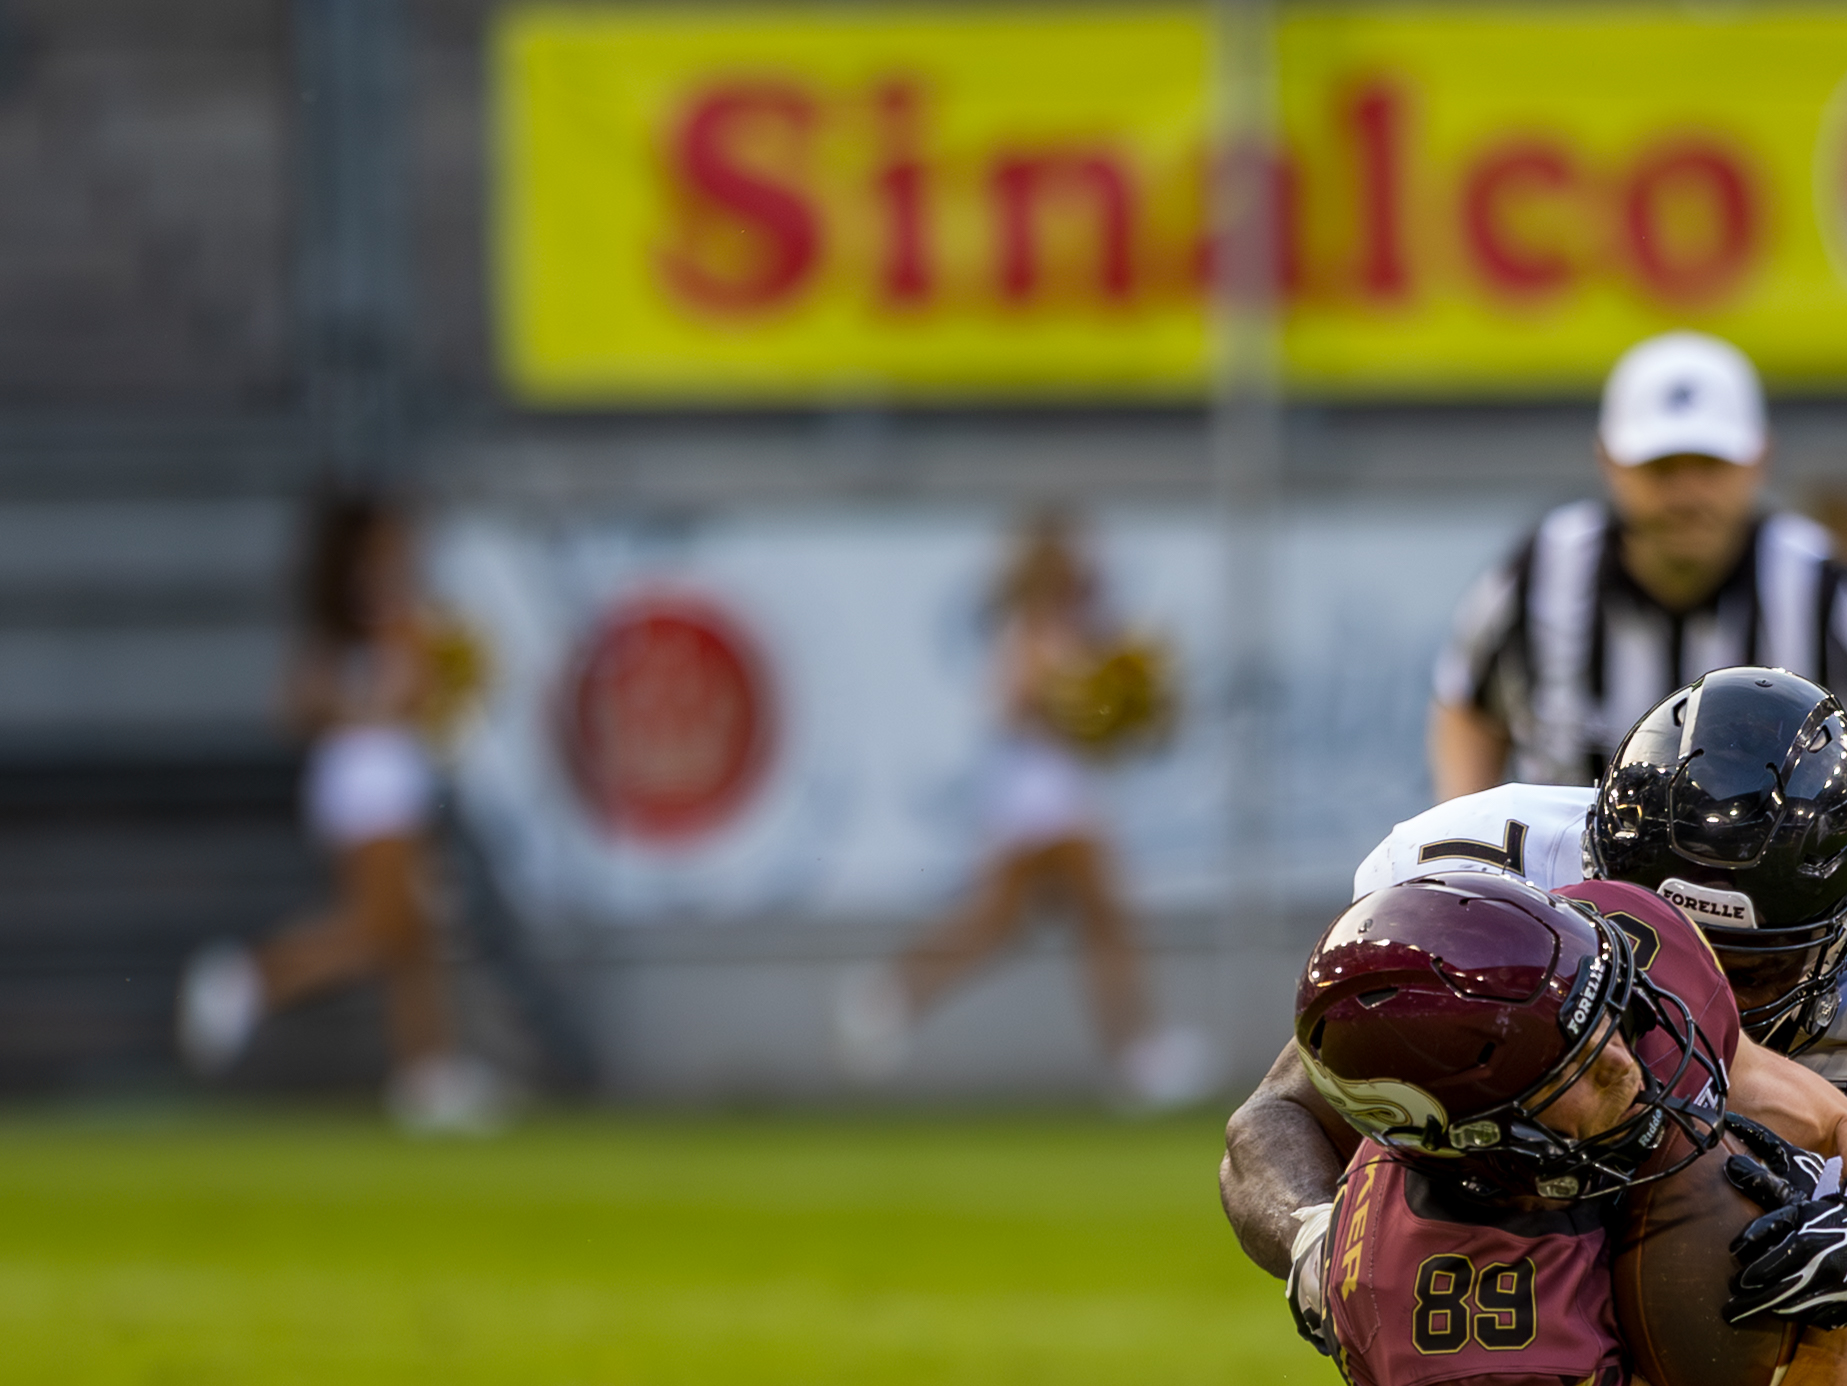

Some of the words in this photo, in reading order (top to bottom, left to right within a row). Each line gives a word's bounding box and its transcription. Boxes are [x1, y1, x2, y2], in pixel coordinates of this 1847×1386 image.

[655, 70, 1760, 325] Sinalco
[1662, 888, 1745, 920] FORELLE
[1412, 1253, 1537, 1355] 89
